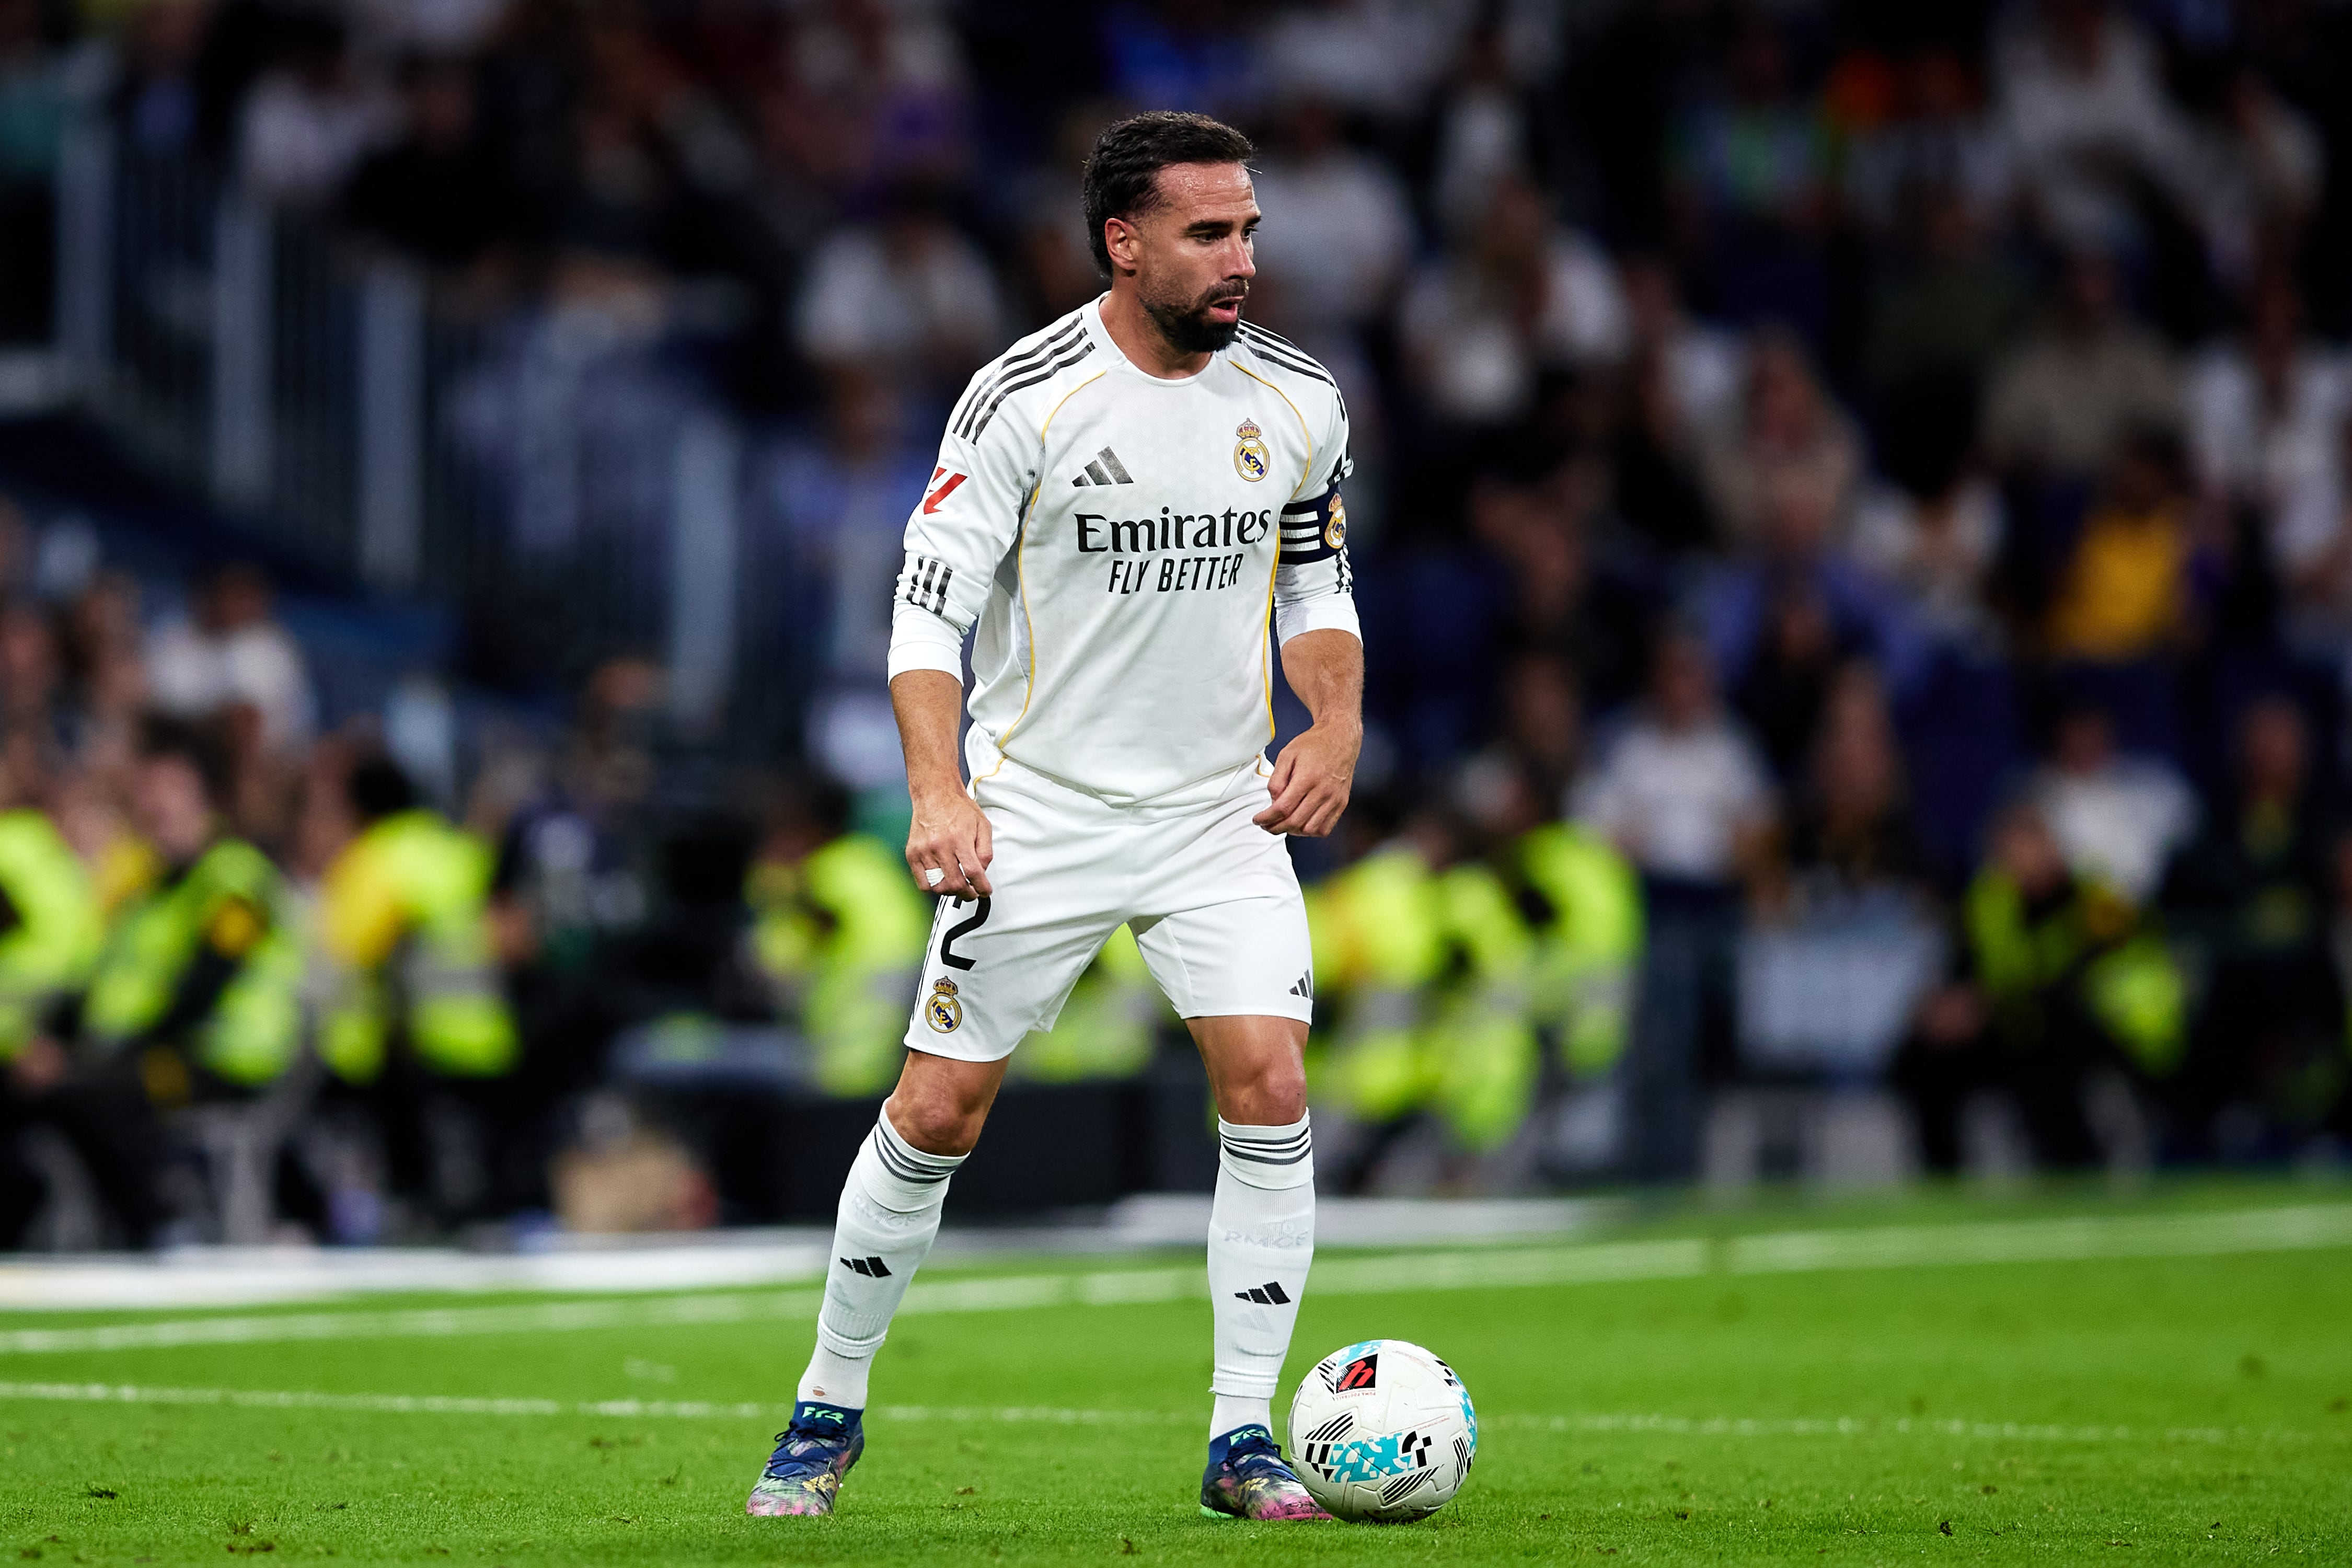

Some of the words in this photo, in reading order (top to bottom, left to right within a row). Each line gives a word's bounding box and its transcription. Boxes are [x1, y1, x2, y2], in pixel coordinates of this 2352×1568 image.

[1074, 506, 1271, 552] Emirates
[1108, 559, 1150, 594] FLY
[1157, 554, 1243, 592] BETTER
[940, 895, 991, 971] 2
